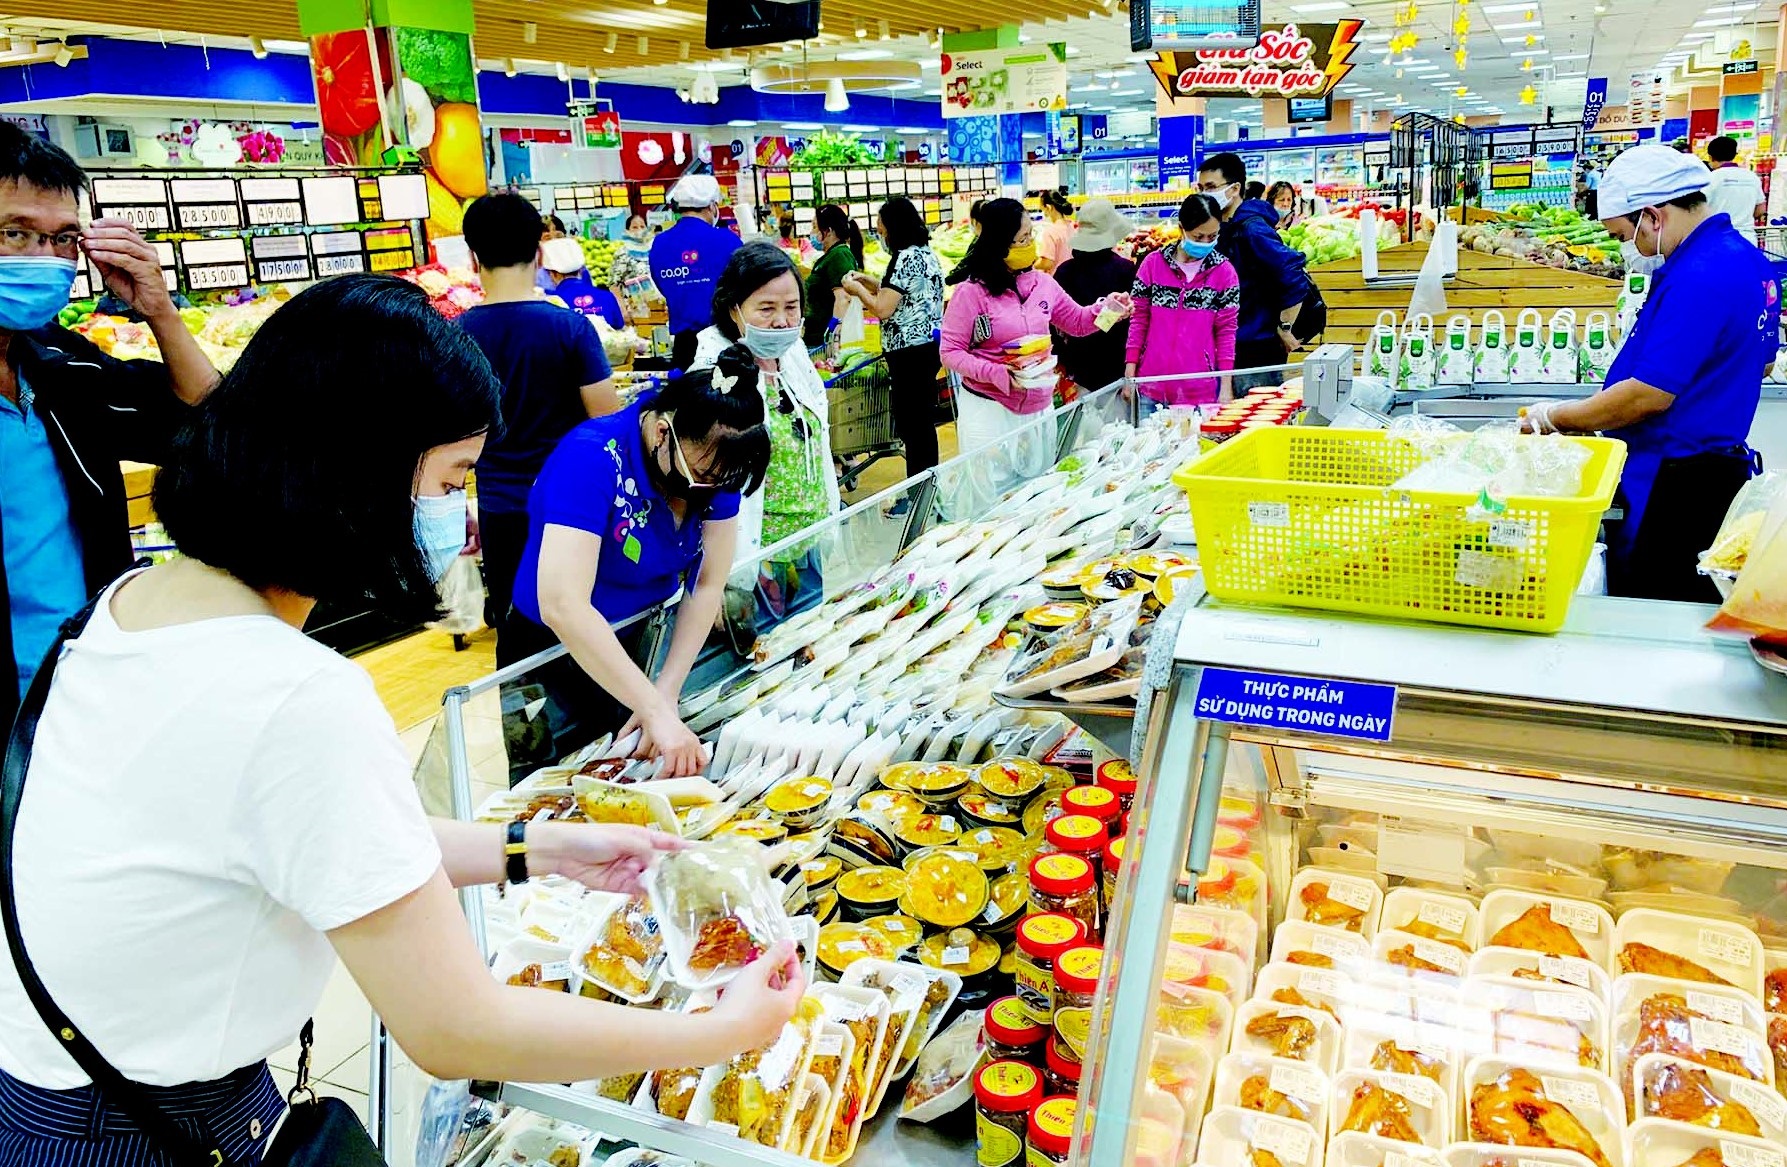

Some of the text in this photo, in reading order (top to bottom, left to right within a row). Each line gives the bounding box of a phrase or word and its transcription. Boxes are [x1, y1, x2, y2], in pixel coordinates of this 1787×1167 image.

[1255, 27, 1308, 59] Sốc
[956, 61, 983, 70] Select
[1181, 63, 1321, 90] giảm tận gốc
[1589, 92, 1603, 102] 01
[1094, 128, 1106, 137] 01
[731, 144, 742, 152] 01
[1163, 155, 1189, 165] Select
[1243, 680, 1344, 704] THỰC PHẨM
[1199, 695, 1386, 733] SỬ DỤNG TRONG NGÀY
